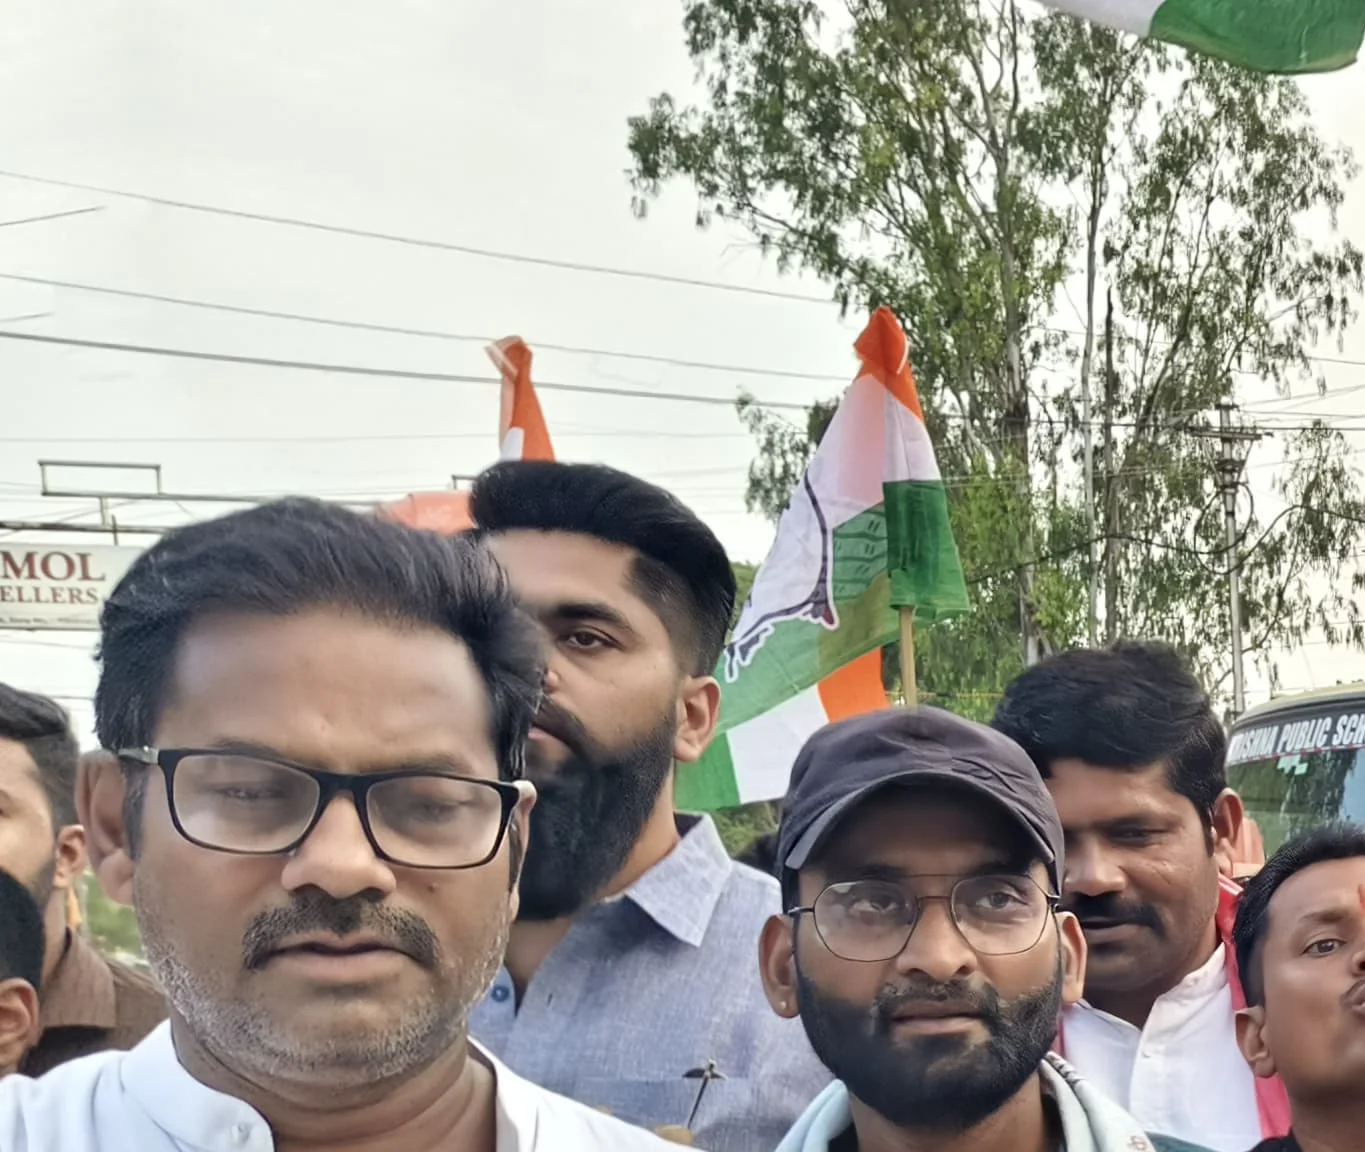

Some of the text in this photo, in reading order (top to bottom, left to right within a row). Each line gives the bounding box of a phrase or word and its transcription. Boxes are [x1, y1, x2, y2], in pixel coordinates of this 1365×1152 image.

[0, 551, 106, 581] MOL
[0, 585, 98, 605] ELLERS
[1277, 716, 1331, 753] PUBLIC
